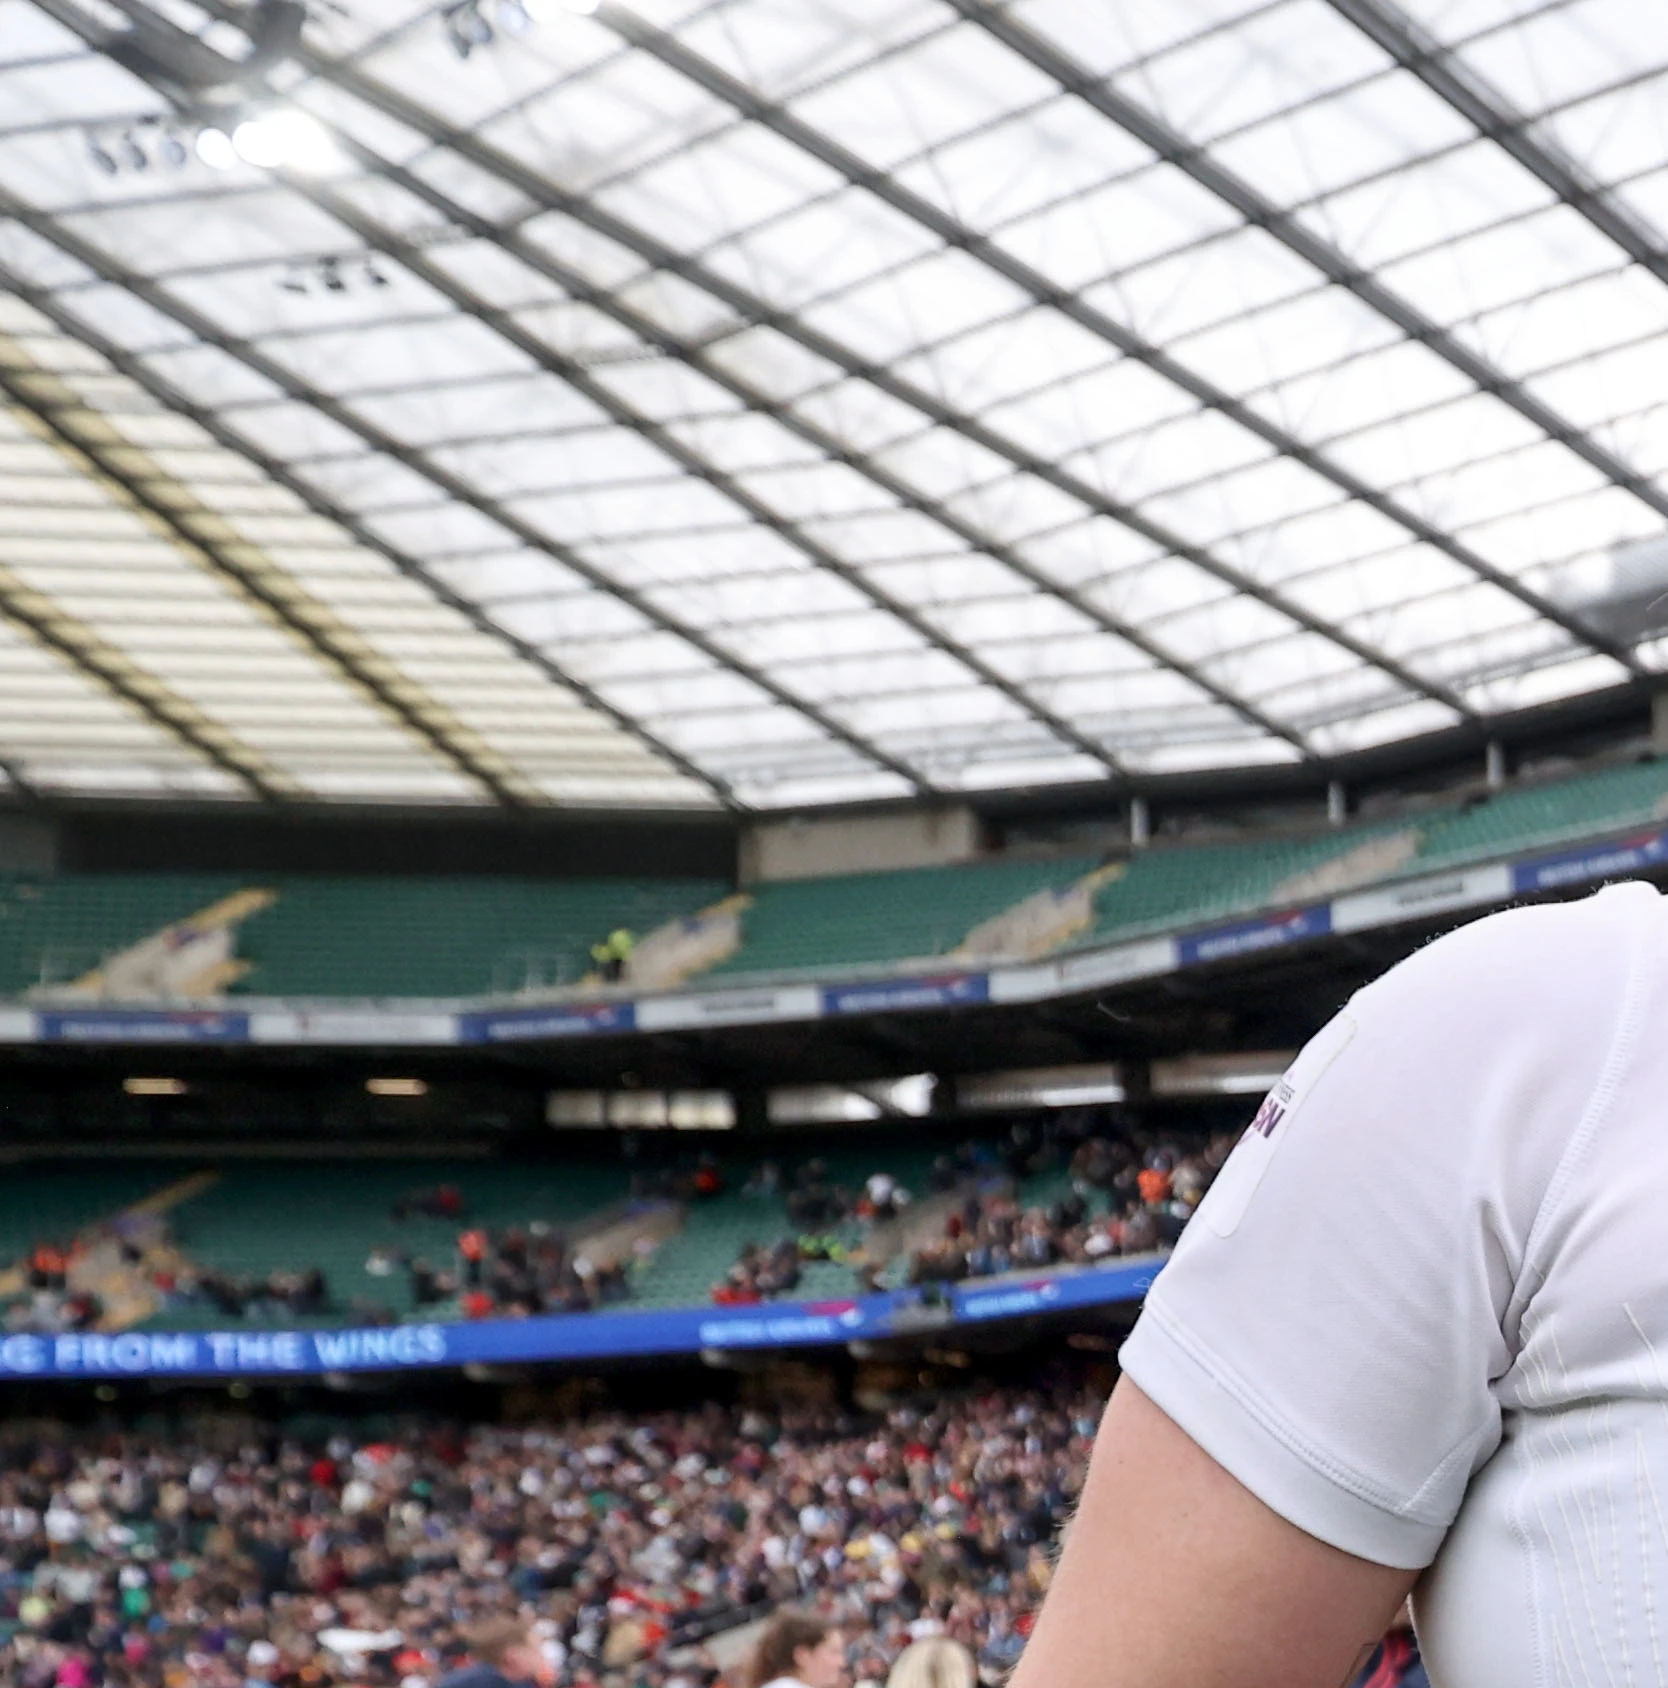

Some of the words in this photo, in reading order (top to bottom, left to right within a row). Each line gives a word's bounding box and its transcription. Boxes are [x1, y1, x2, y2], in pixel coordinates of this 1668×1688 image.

[54, 1331, 199, 1371] FROM
[206, 1331, 302, 1370] THE
[312, 1324, 448, 1367] WINGS
